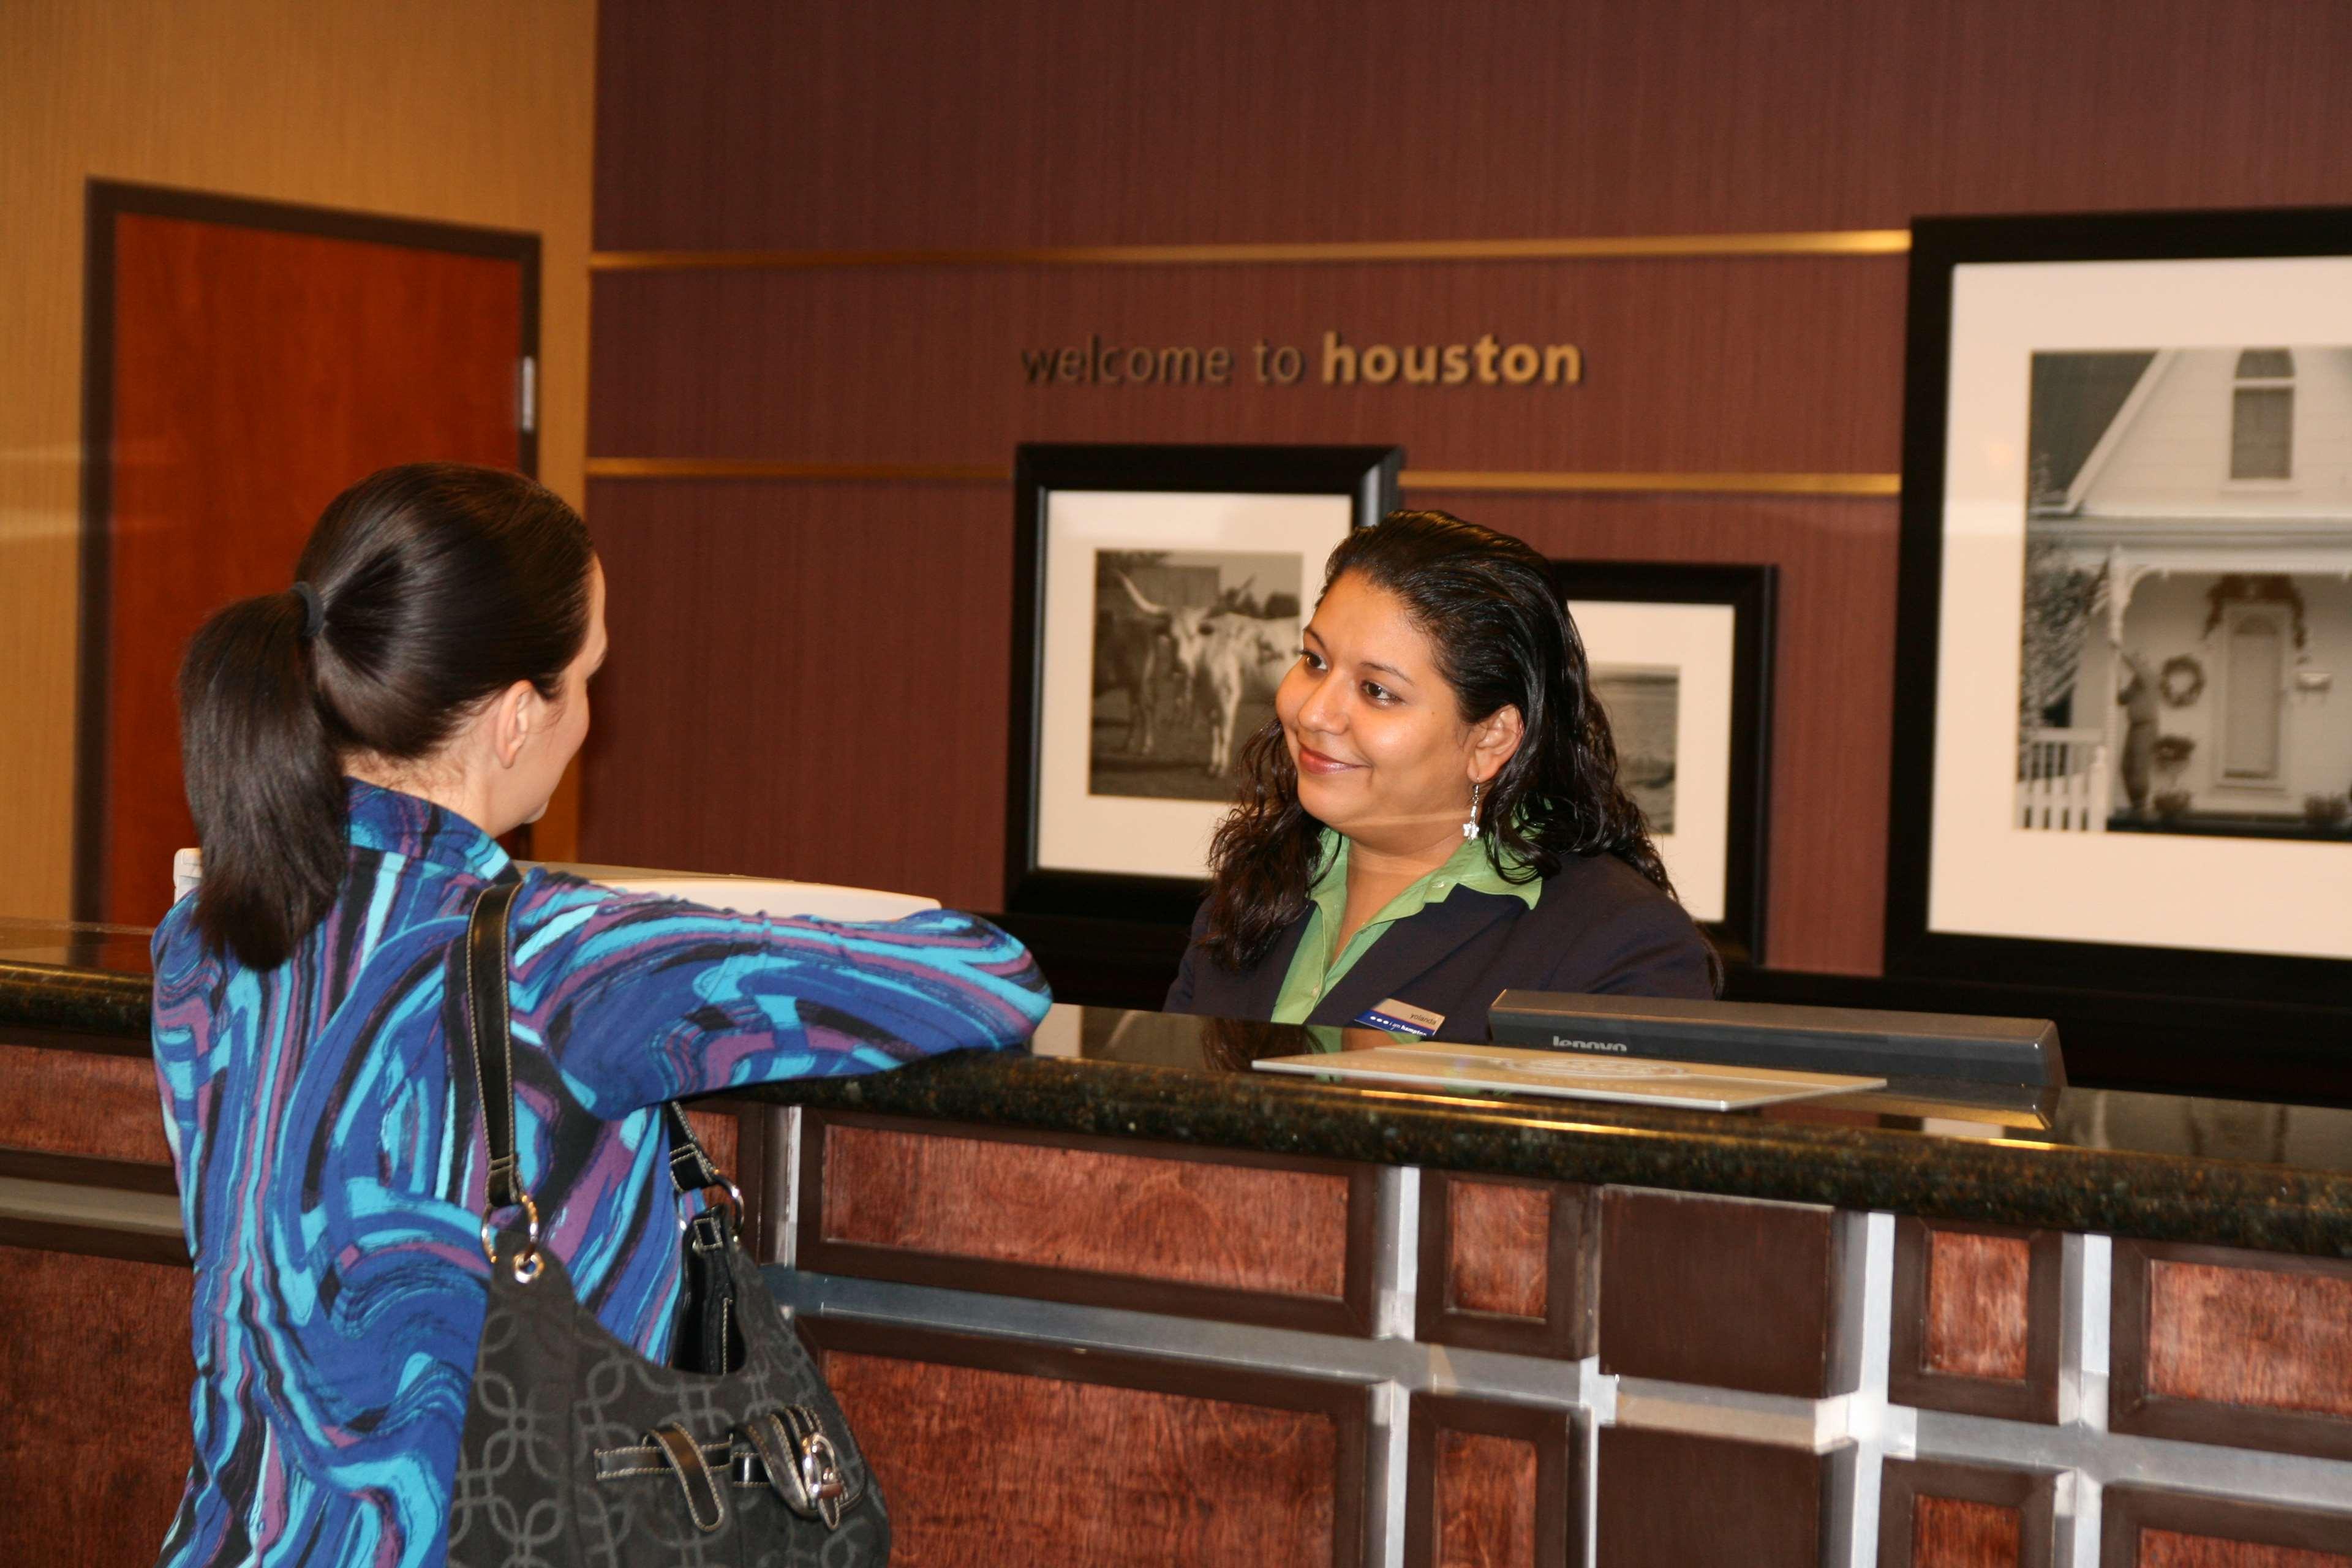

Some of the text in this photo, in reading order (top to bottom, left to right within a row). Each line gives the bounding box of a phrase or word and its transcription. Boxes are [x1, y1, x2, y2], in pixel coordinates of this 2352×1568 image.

[1022, 330, 1581, 385] welcome to houston
